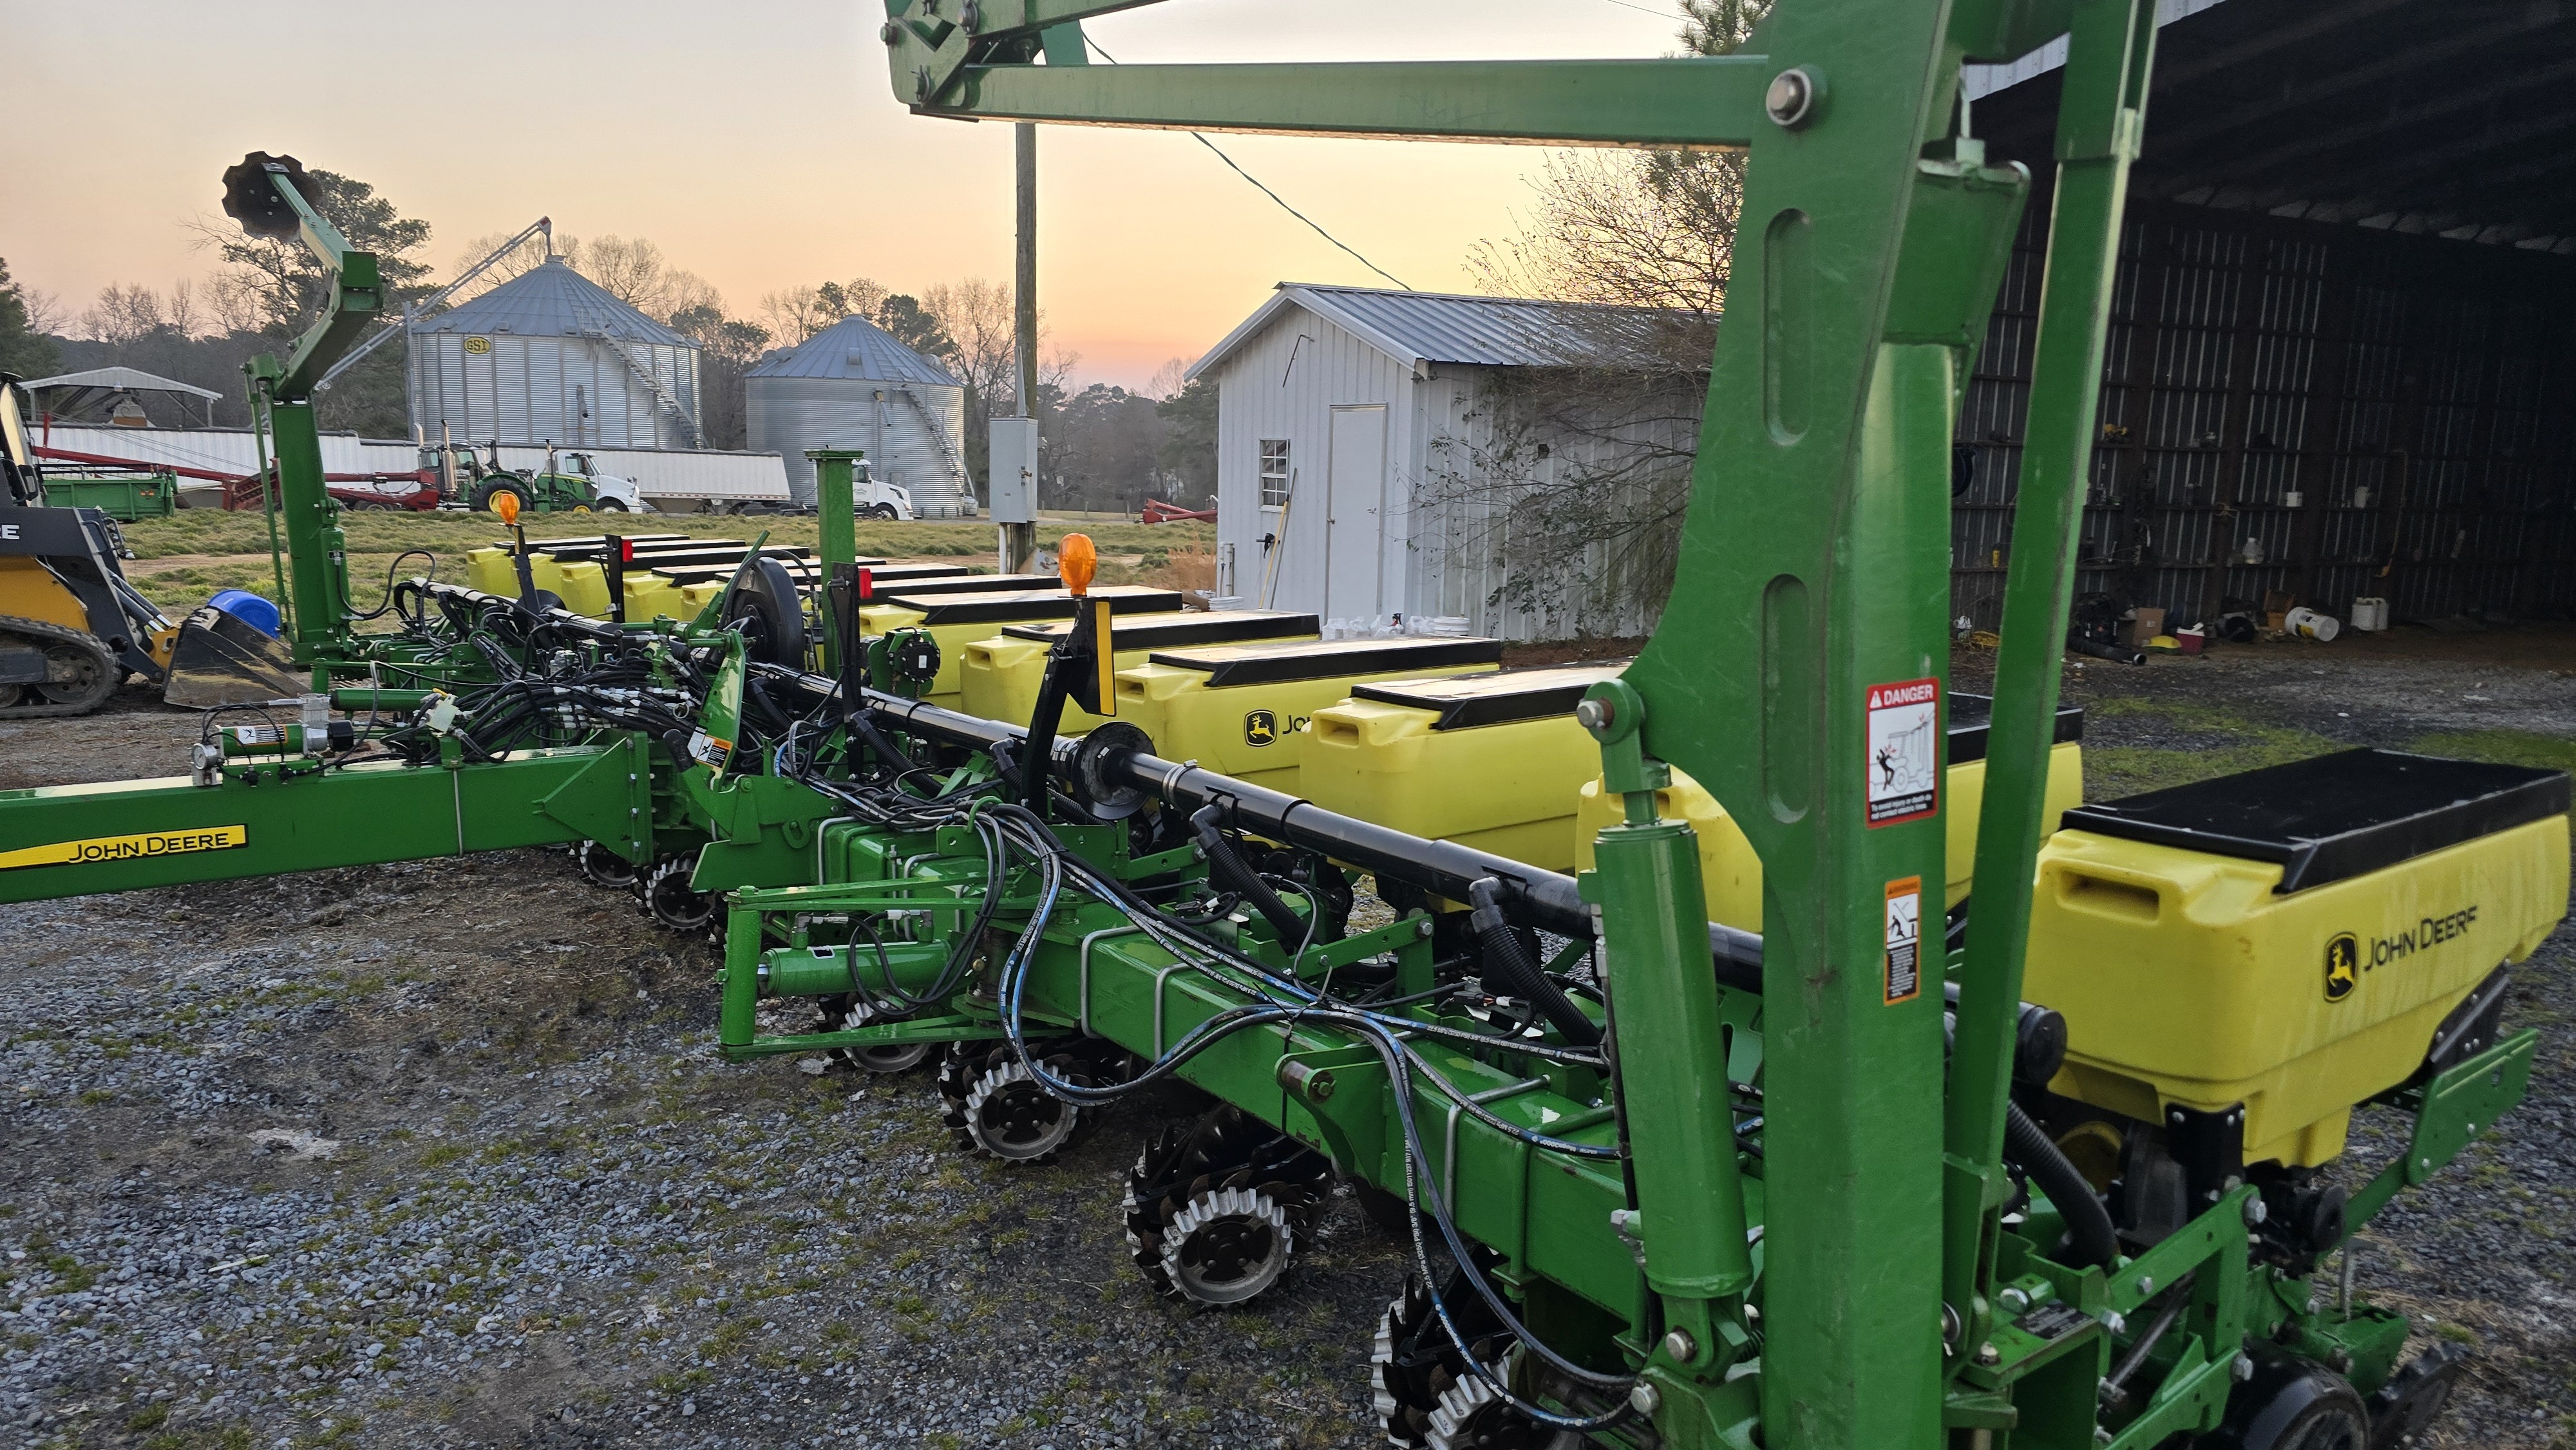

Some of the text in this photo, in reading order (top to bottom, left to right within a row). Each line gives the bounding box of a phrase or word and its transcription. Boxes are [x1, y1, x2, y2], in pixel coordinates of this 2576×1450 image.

[467, 340, 487, 351] GSI
[0, 525, 20, 540] E
[1884, 684, 1934, 706] DANGER
[69, 833, 229, 862] JOHN DEERE
[2363, 928, 2416, 972] JOHN
[1417, 1242, 1426, 1259] (3250
